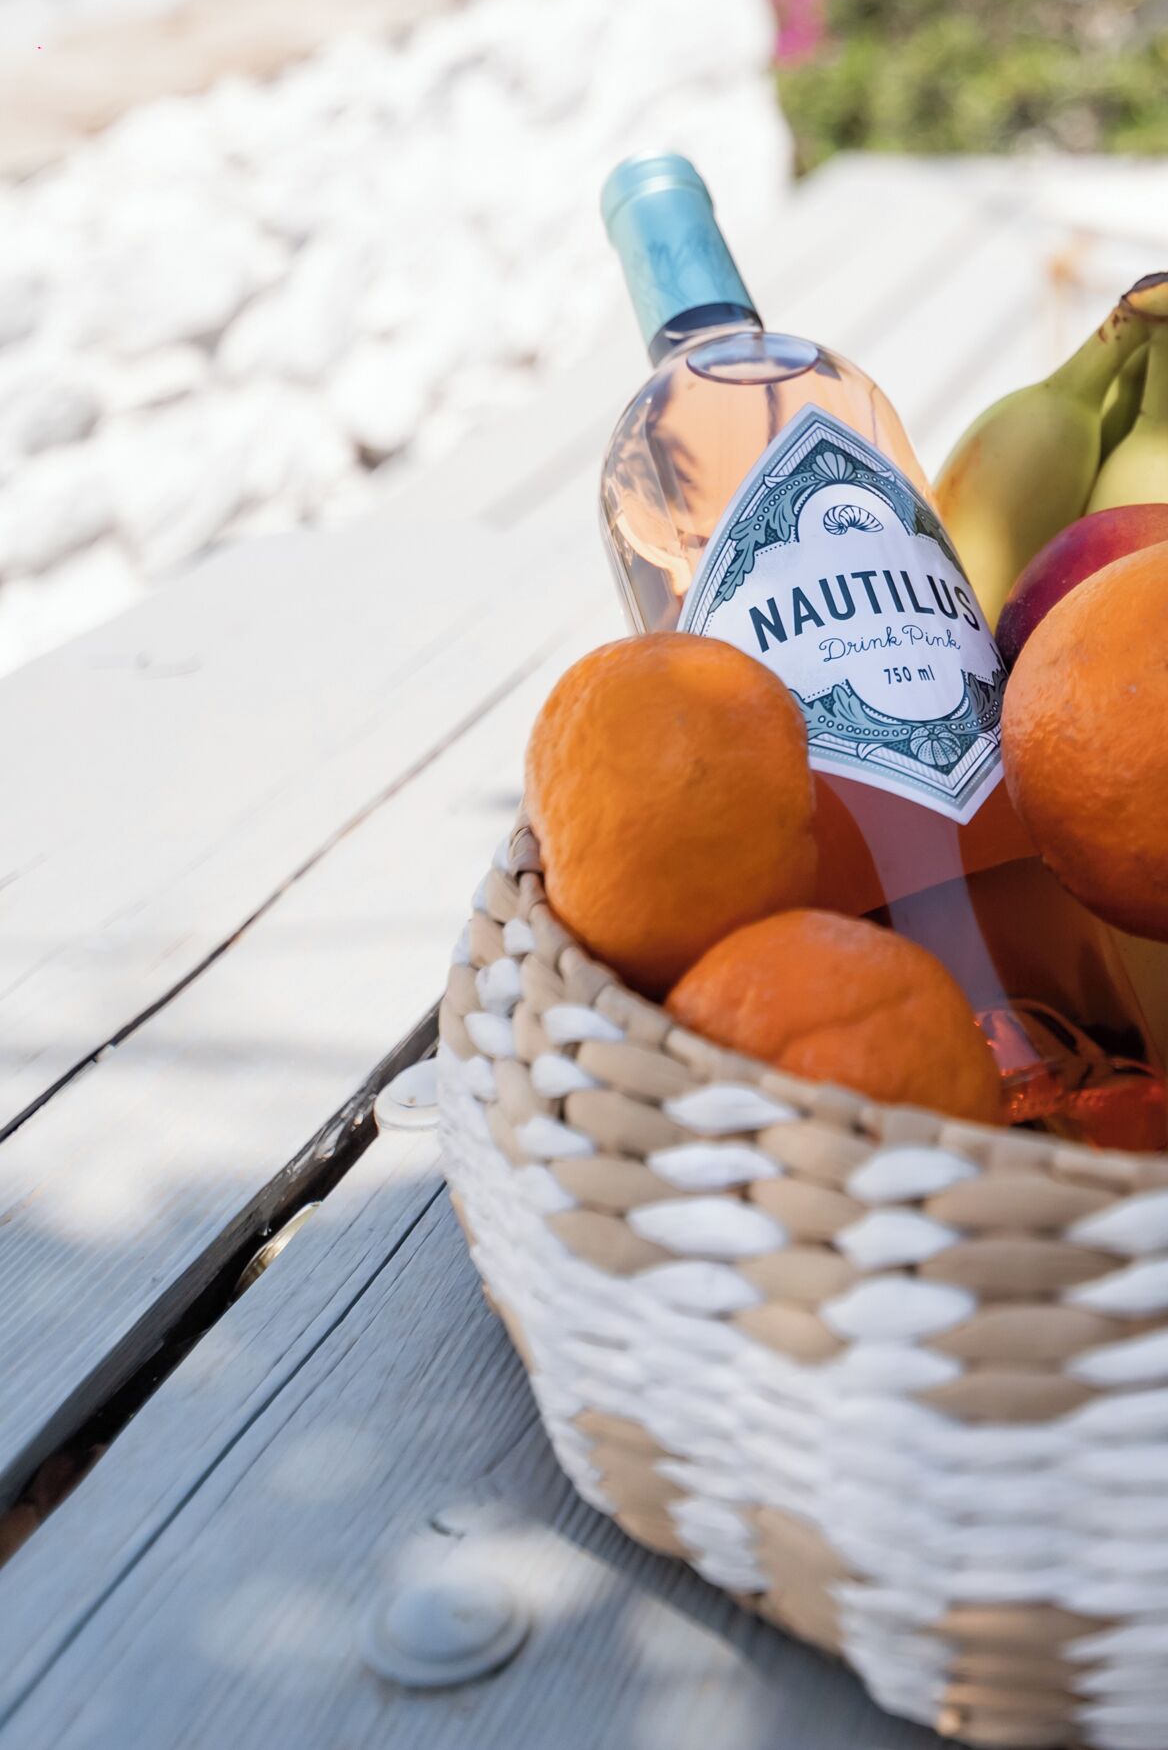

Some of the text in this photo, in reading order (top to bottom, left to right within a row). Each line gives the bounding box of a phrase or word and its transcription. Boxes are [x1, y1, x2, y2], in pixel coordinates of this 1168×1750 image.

[749, 569, 980, 652] NAUTILUS
[818, 624, 961, 662] Drink Pink
[883, 664, 936, 684] 750 ml
